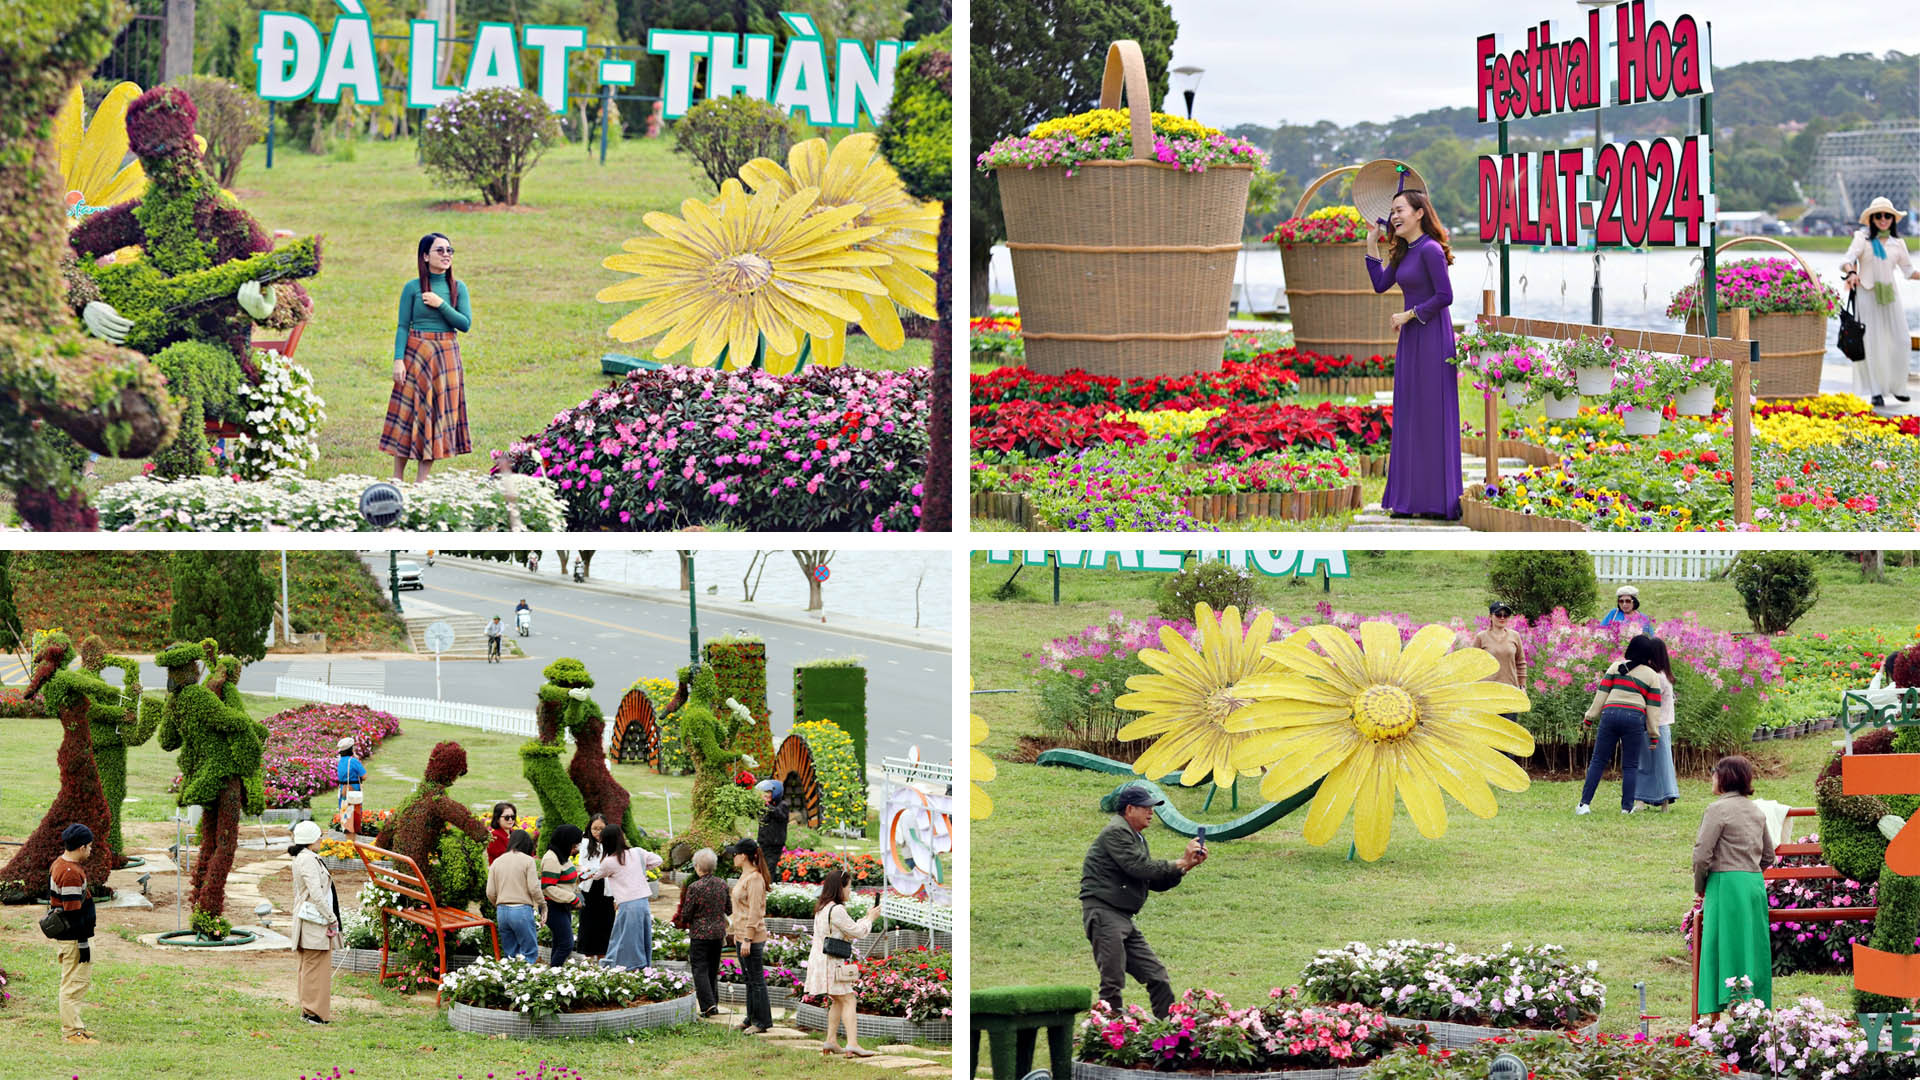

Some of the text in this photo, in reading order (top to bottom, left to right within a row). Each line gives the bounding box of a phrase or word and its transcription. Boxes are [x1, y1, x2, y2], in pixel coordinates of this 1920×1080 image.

[253, 0, 918, 128] ĐÀ LAT - THÀN
[1476, 0, 1704, 124] Festival Hoa
[1477, 134, 1706, 248] DALAT-2024
